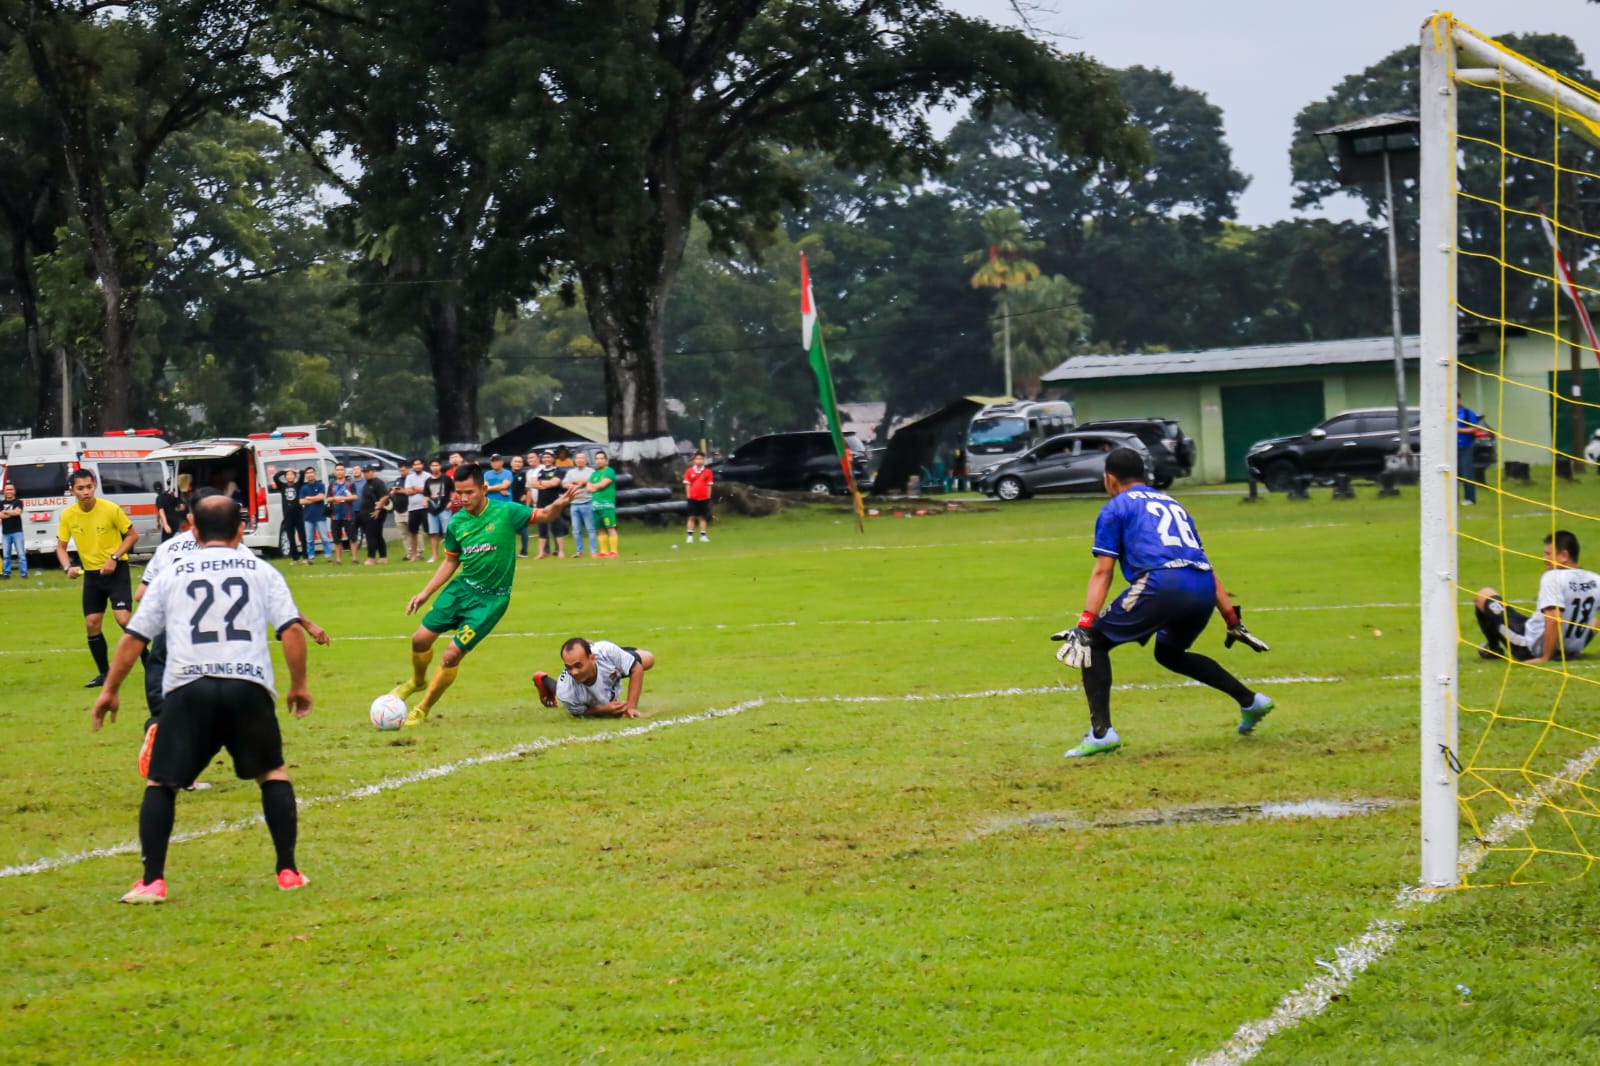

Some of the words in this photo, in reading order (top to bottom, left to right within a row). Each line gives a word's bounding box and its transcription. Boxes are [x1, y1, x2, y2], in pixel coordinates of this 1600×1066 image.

[22, 497, 68, 506] BULANCE
[1146, 501, 1200, 549] 26
[175, 562, 195, 576] PS
[200, 558, 257, 572] PEMKO
[186, 576, 253, 645] 22
